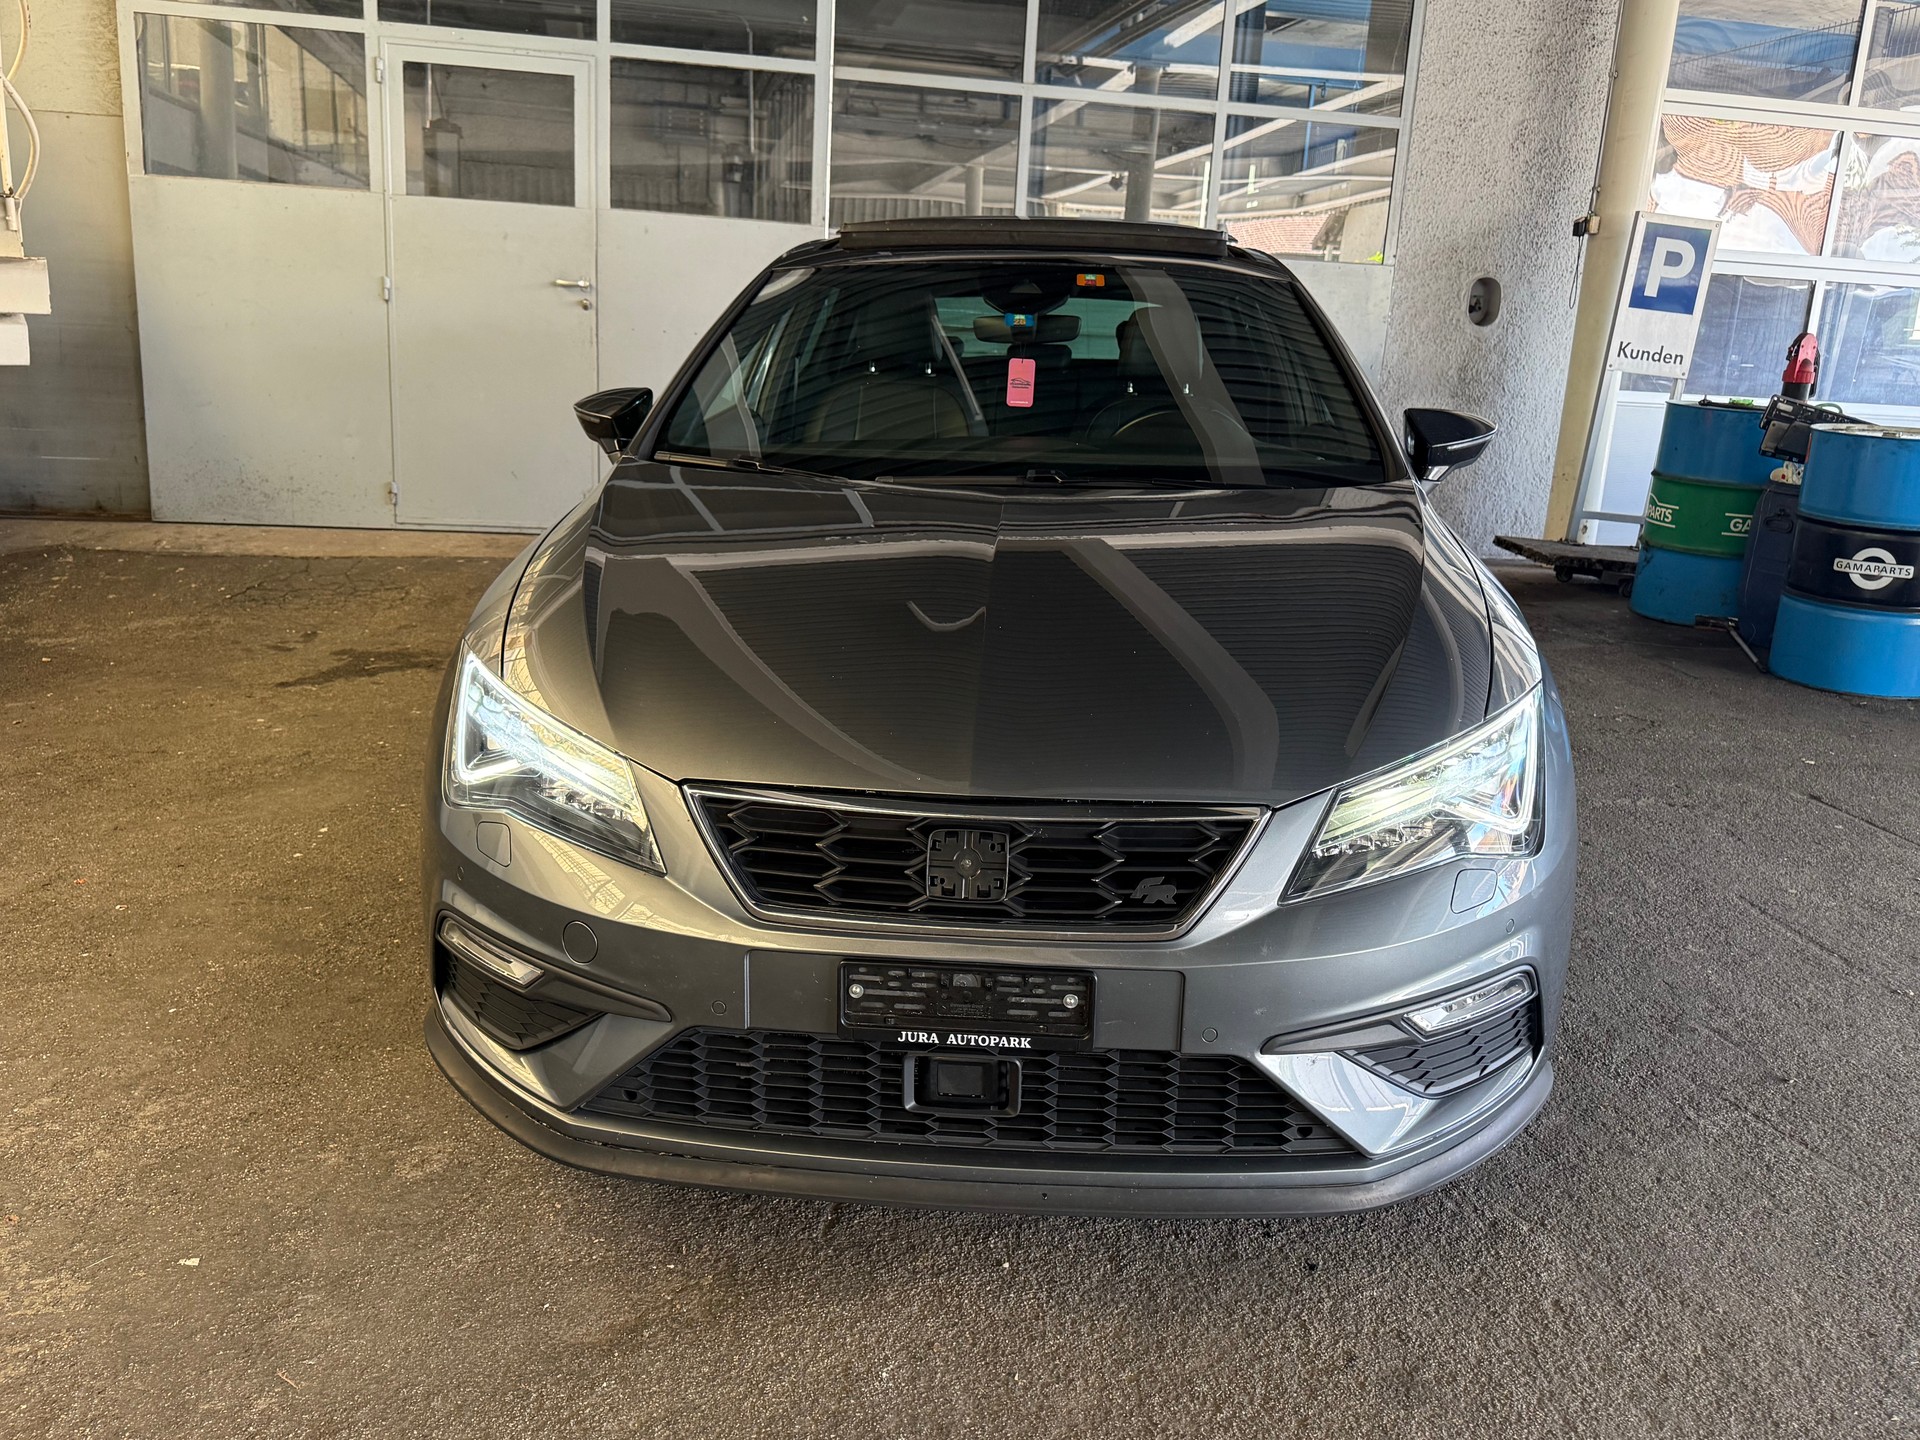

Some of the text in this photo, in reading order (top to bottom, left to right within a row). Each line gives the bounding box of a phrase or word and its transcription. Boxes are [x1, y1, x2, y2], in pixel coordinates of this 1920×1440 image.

[1643, 236, 1696, 298] P
[1617, 341, 1684, 366] Kunden
[1836, 560, 1912, 577] GAMAPARTS
[897, 1031, 1032, 1049] JURA AUTOPARK
